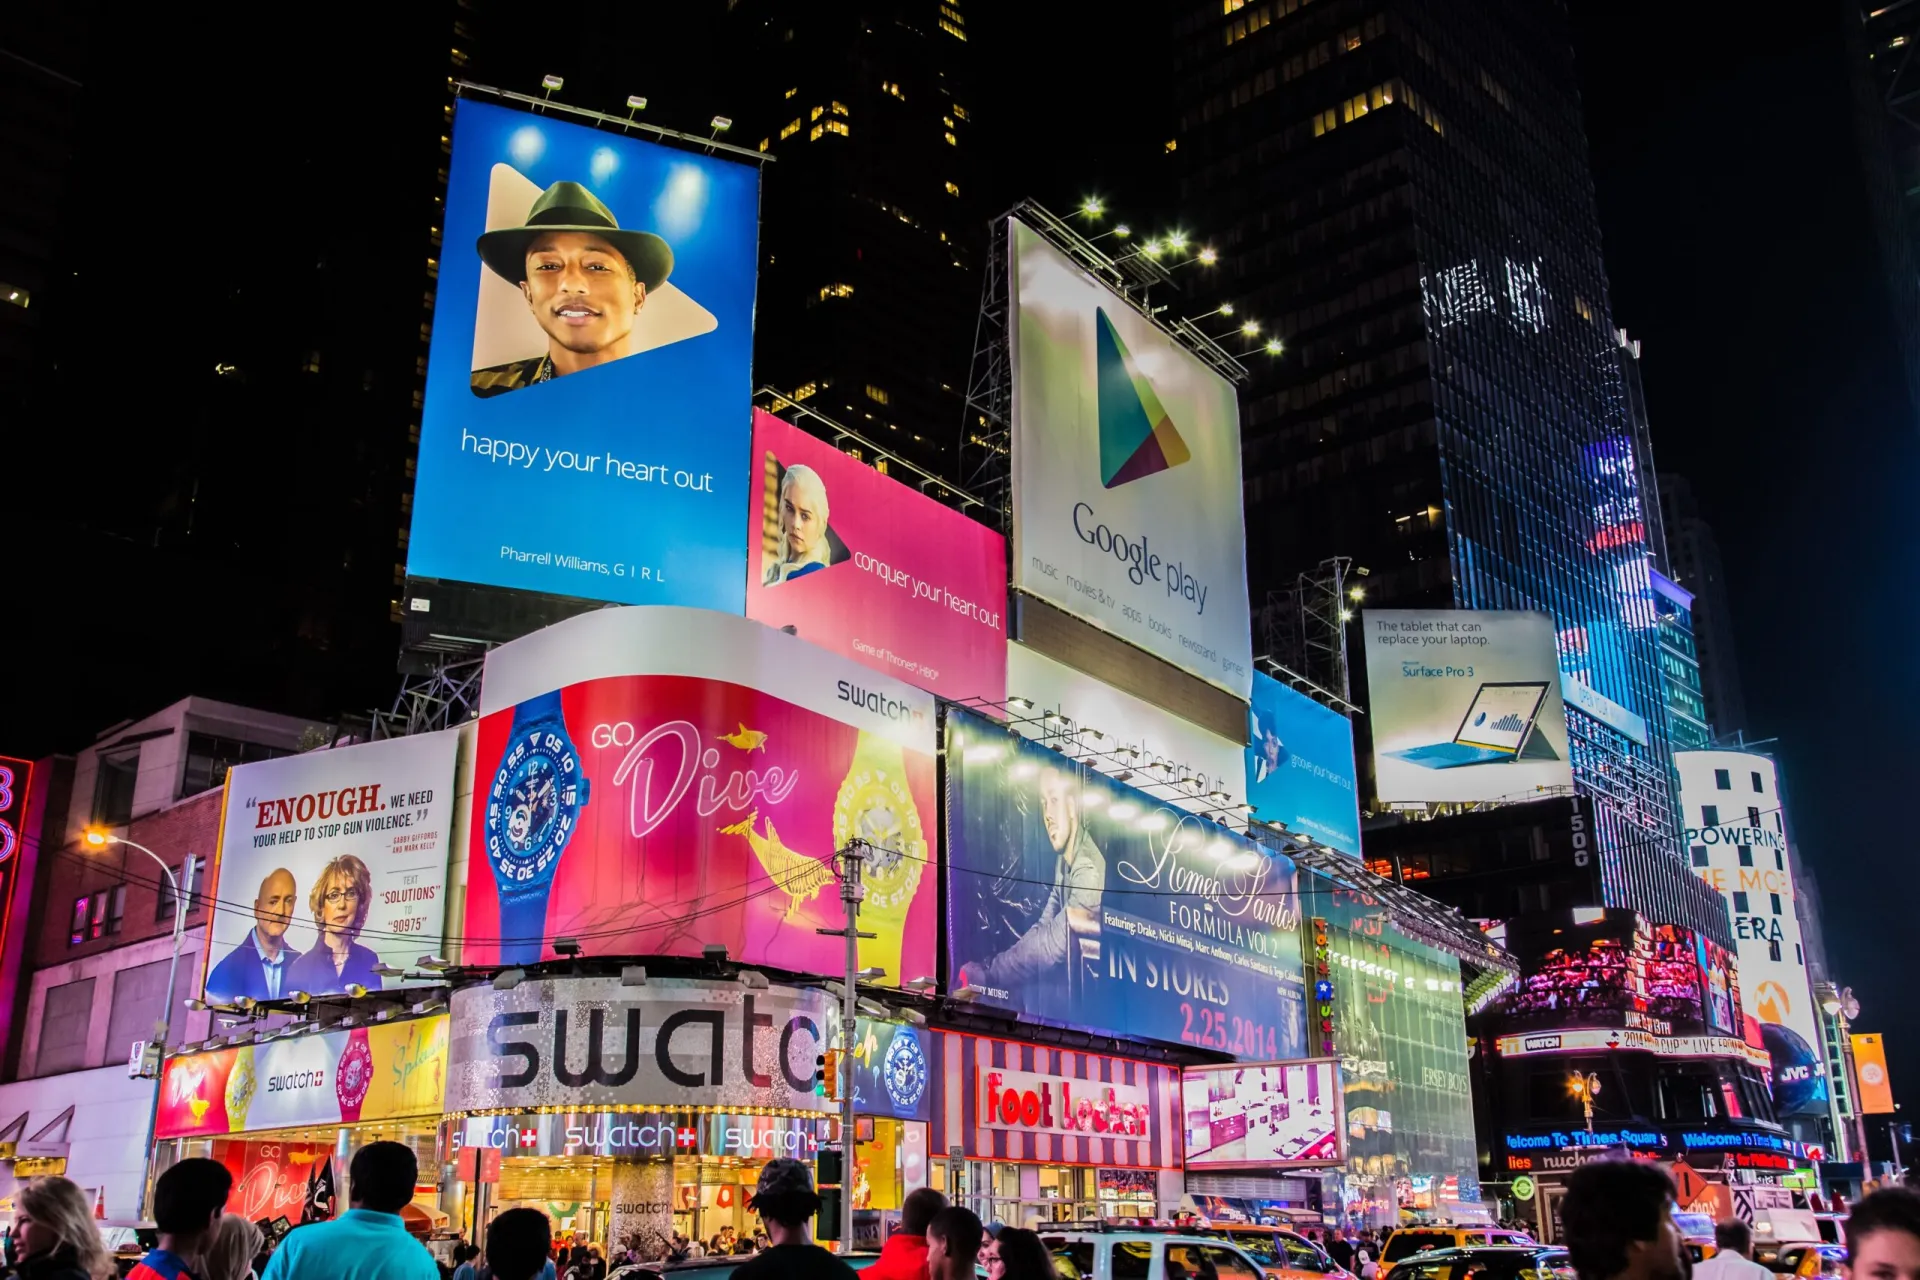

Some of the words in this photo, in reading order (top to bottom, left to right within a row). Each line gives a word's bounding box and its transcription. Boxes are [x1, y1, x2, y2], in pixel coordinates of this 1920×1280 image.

[462, 428, 538, 469] happy
[544, 449, 600, 474] your
[606, 451, 669, 486] heart
[674, 467, 714, 494] out
[500, 545, 551, 566] Pharrell
[554, 552, 611, 577] Williams,
[1073, 502, 1162, 586] Google
[1166, 561, 1208, 616] play
[854, 551, 911, 588] conquer
[911, 578, 941, 603] your
[944, 586, 978, 621] heart
[979, 608, 1000, 631] out
[1032, 555, 1059, 581] music
[1121, 603, 1143, 625] apps
[1148, 614, 1173, 641] books
[1178, 632, 1217, 664] newsstand
[1222, 657, 1245, 678] games
[1377, 621, 1398, 632] The
[1400, 621, 1433, 632] tablet
[1436, 621, 1459, 632] that
[1461, 623, 1482, 632] can
[852, 638, 875, 657] Game
[876, 647, 886, 659] of
[1378, 634, 1420, 648] replace
[1421, 636, 1448, 648] your
[1450, 634, 1491, 648] laptop.
[1402, 665, 1443, 678] Surface
[1446, 665, 1465, 678] Pro
[1467, 665, 1475, 678] 3
[837, 680, 912, 722] swatch
[591, 721, 635, 749] GO
[528, 760, 539, 776] 12
[612, 719, 799, 838] Dive
[390, 794, 405, 809] WE
[407, 789, 434, 806] NEED
[1197, 772, 1225, 806] out
[253, 832, 277, 848] YOUR
[278, 829, 302, 845] HELP
[304, 827, 316, 841] TO
[317, 823, 341, 839] STOP
[343, 820, 363, 836] GUN
[393, 834, 411, 845] GABBY
[411, 831, 438, 843] GIFFORDS
[524, 837, 532, 851] 6
[1687, 827, 1785, 850] POWERING
[392, 845, 403, 854] AND
[404, 843, 420, 853] MARK
[420, 841, 436, 850] KELLY
[403, 874, 419, 885] TEXT
[1117, 807, 1221, 903] Romeo
[1214, 850, 1298, 933] Santos
[404, 905, 413, 915] TO
[1104, 912, 1138, 936] Featuring:
[1137, 922, 1159, 941] Drake,
[1159, 928, 1176, 945] Nicki
[1176, 934, 1195, 953] Minaj,
[1195, 940, 1210, 954] Marc
[1233, 953, 1251, 968] Carlos
[1170, 901, 1244, 948] FORMULA
[1246, 928, 1268, 957] VOL
[1271, 938, 1278, 959] 2
[1737, 916, 1784, 941] ERA
[1108, 944, 1137, 983] IN
[1146, 955, 1230, 1006] STORES
[988, 987, 1009, 1000] MUSIC
[1180, 1002, 1277, 1061] 2.25.2014
[1625, 1011, 1642, 1028] JUNE
[486, 994, 838, 1094] swatc
[1525, 1036, 1561, 1050] WATCH
[1624, 1032, 1645, 1048] 2014
[1692, 1039, 1715, 1054] LIVE
[268, 1069, 314, 1093] swatch
[1421, 1066, 1447, 1089] JERSEY
[1449, 1072, 1468, 1093] BOYS
[1781, 1065, 1809, 1081] JVC
[985, 1073, 1053, 1128] Foot
[1060, 1082, 1150, 1136] Locker
[565, 1121, 676, 1148] swatch
[725, 1128, 808, 1152] swatch
[1682, 1132, 1742, 1148] Welcome
[1742, 1132, 1752, 1146] To
[260, 1144, 281, 1158] GO
[1508, 1155, 1532, 1169] lies
[615, 1202, 669, 1215] swatch
